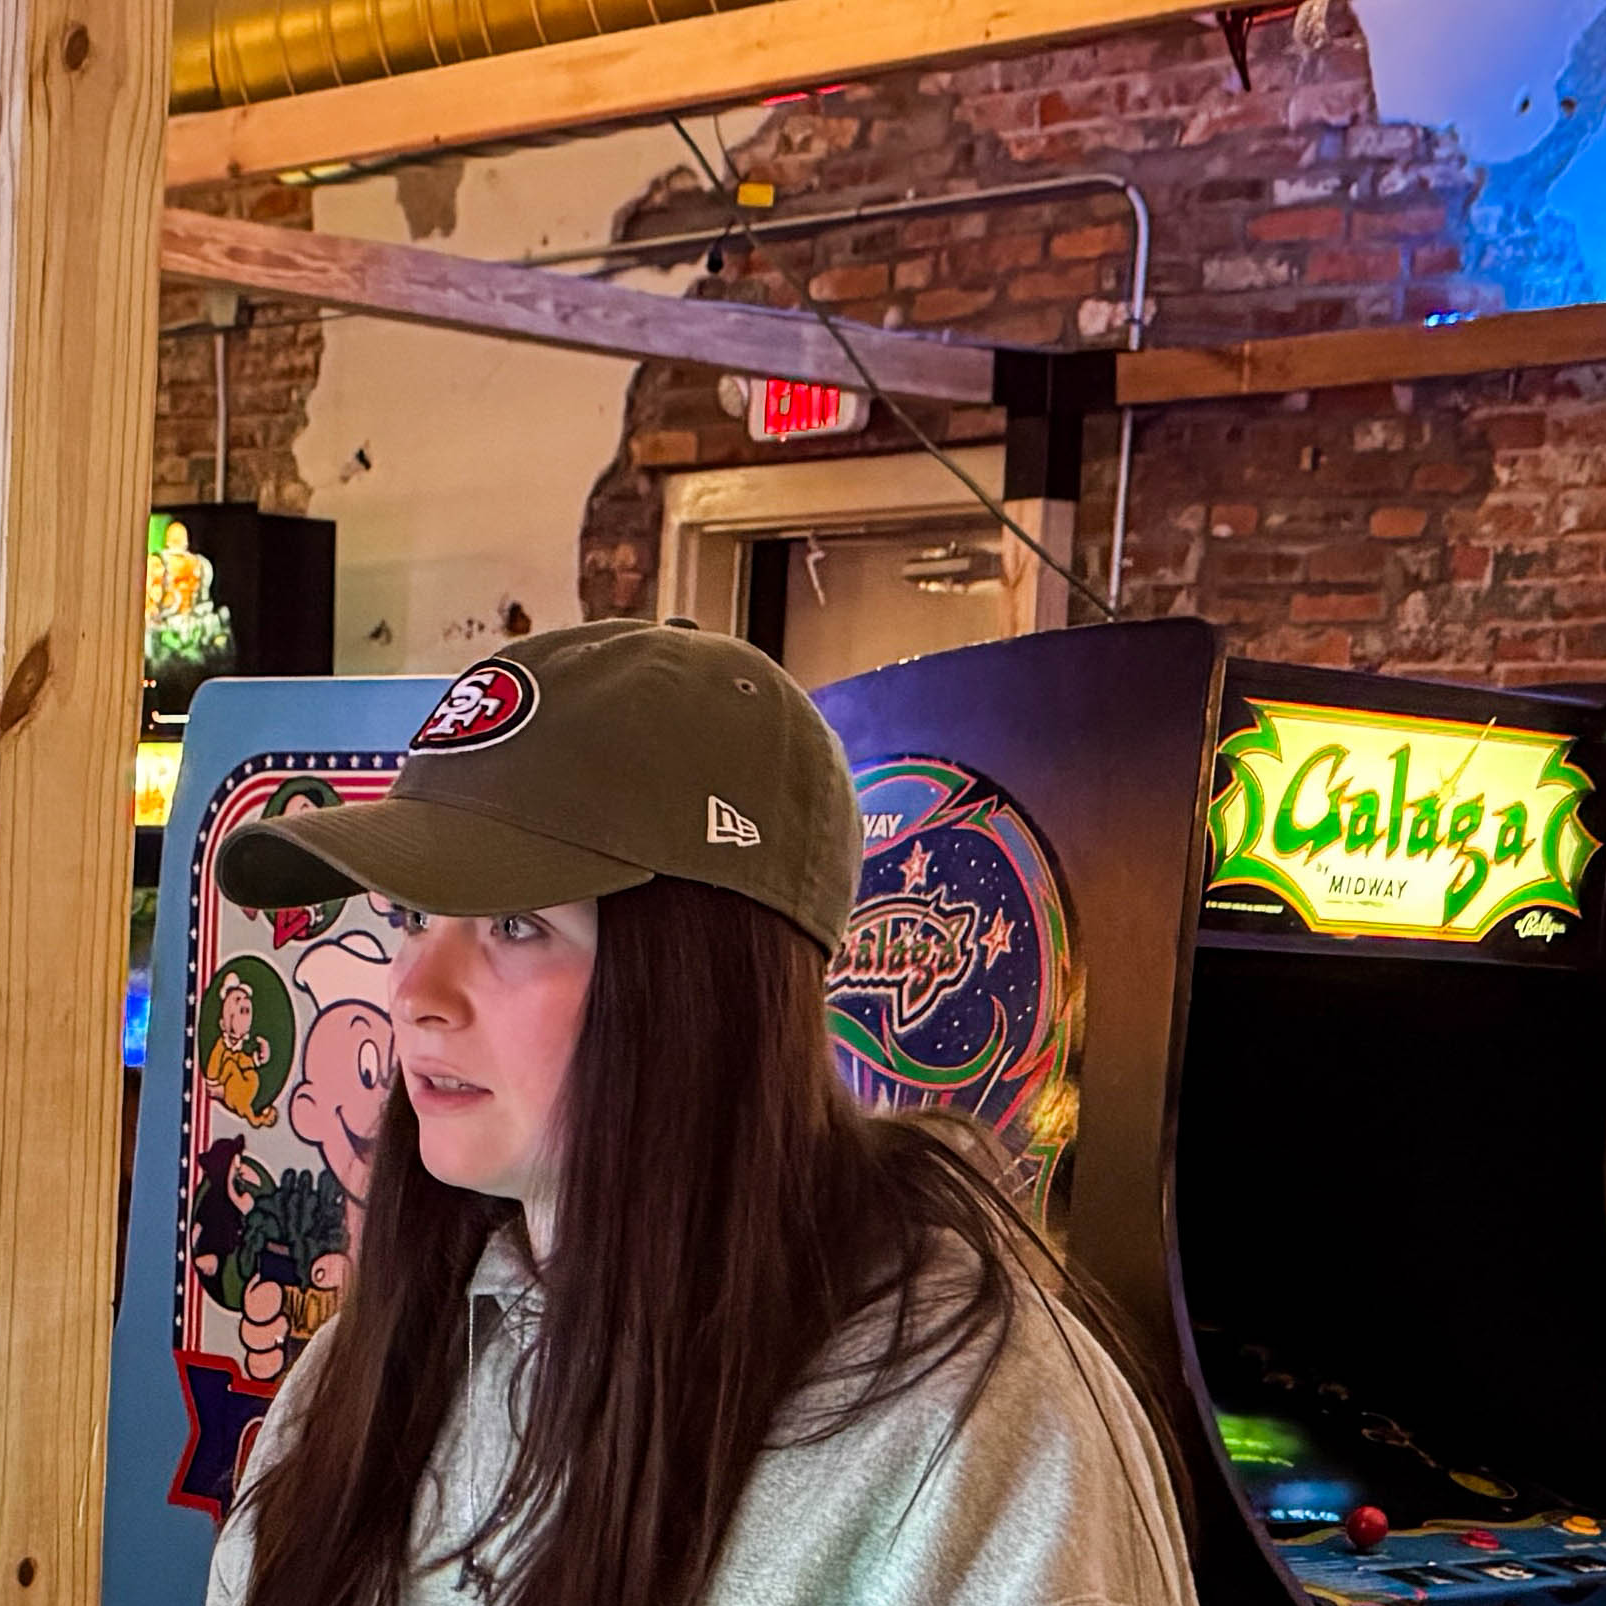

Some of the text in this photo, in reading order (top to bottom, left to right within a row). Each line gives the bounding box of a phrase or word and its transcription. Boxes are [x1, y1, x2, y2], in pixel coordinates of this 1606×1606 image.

[424, 672, 502, 736] SF
[1272, 740, 1536, 926] Galaga
[1328, 874, 1409, 900] MIDWAY
